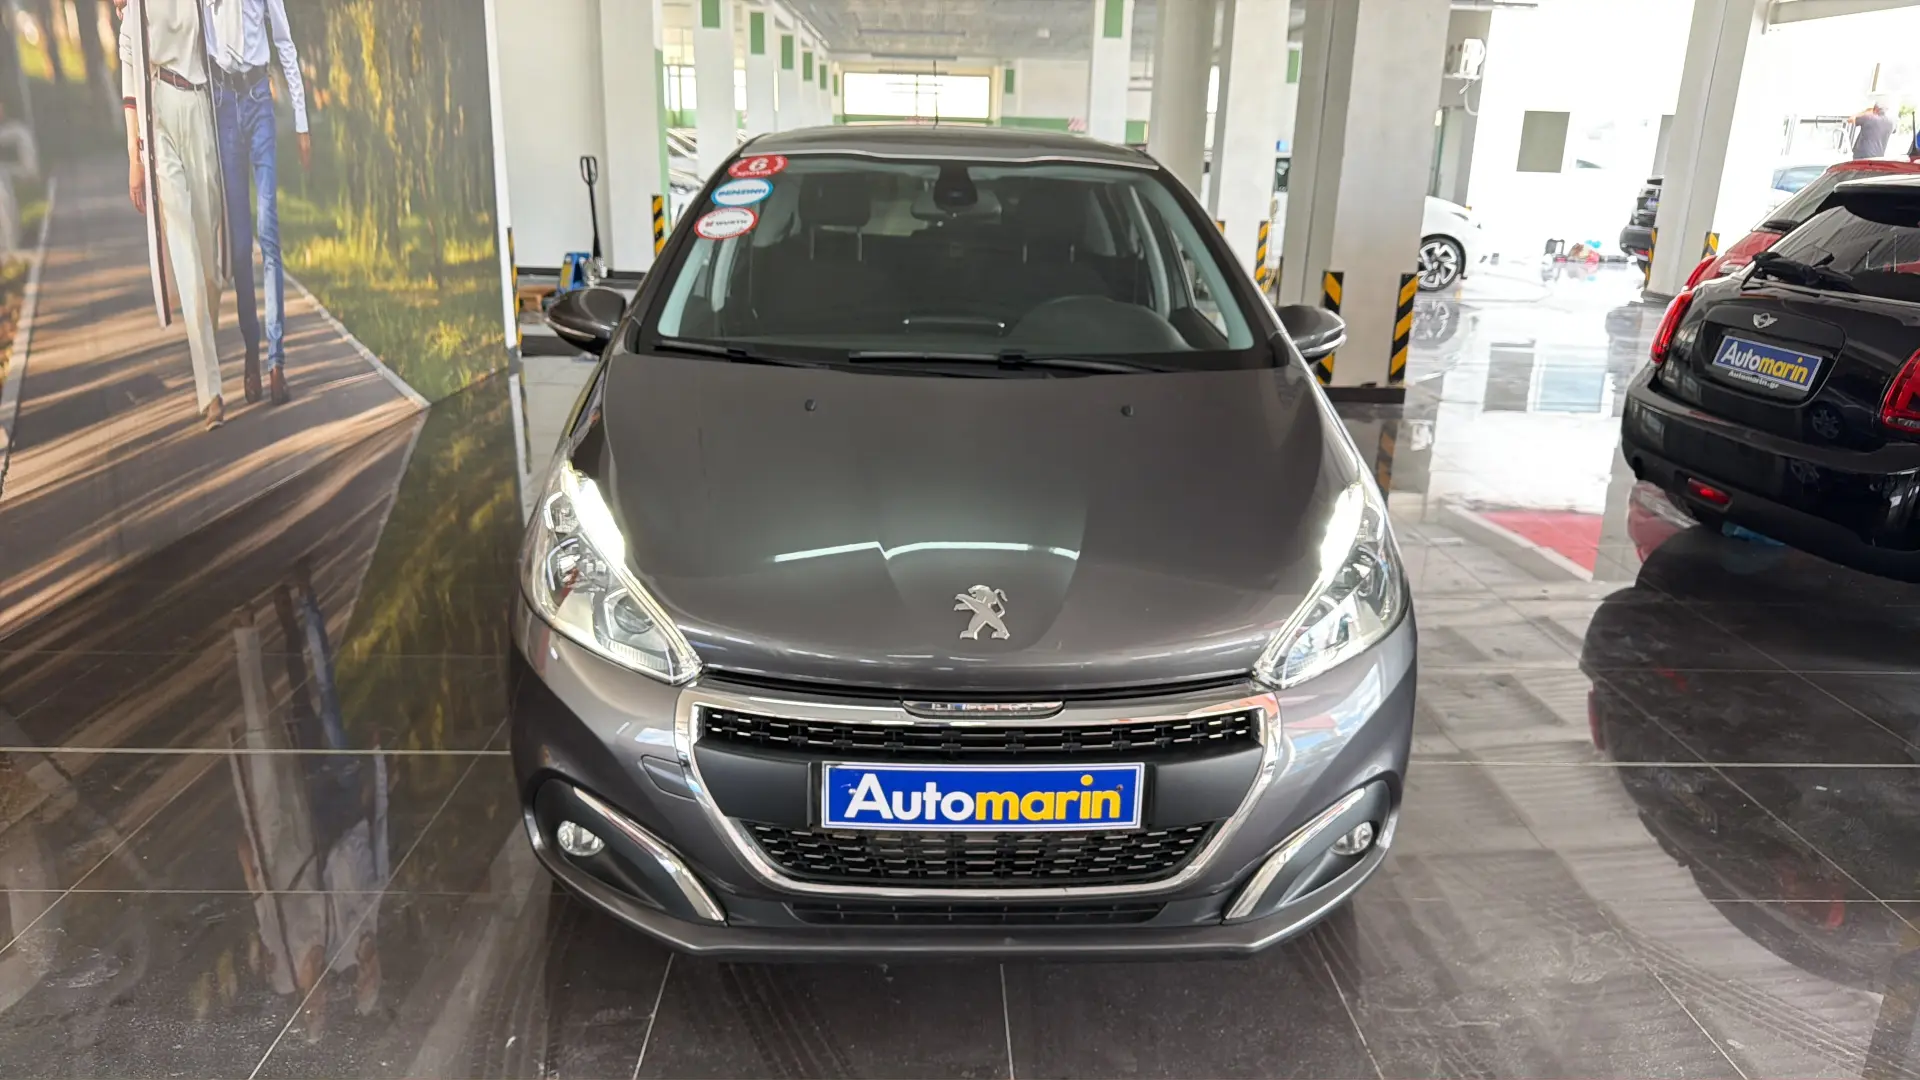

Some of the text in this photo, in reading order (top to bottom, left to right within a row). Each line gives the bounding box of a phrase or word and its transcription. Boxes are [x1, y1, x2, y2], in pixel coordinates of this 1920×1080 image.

[748, 158, 769, 172] 6
[1720, 341, 1809, 384] Automarin
[1728, 369, 1780, 390] Automarin.gr
[844, 773, 1121, 821] Automarin
